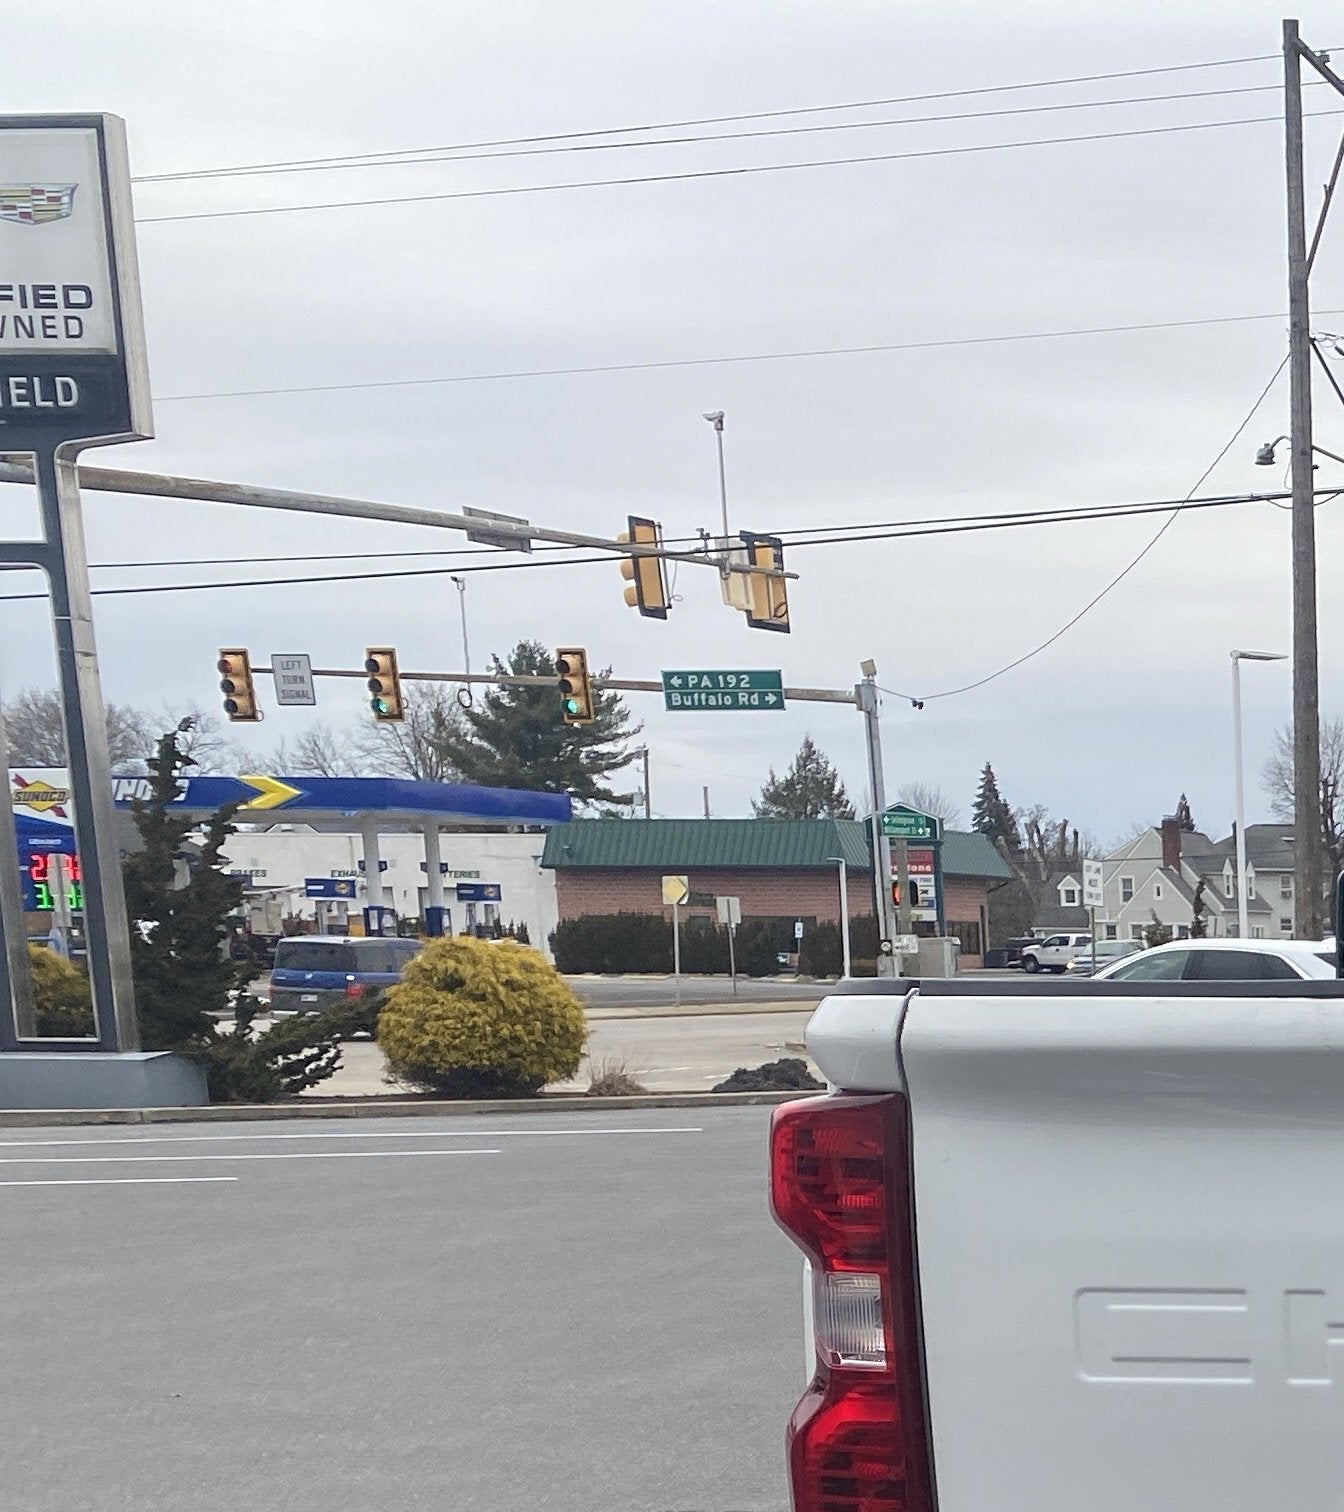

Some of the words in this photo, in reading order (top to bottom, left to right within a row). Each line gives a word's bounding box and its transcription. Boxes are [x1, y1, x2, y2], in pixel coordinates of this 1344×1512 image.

[0, 376, 79, 408] ELD
[281, 660, 301, 670] LEFT
[282, 675, 305, 684] TURN
[688, 675, 712, 688] PA
[718, 674, 751, 688] 192
[281, 689, 312, 699] SIGNAL
[671, 692, 732, 706] Buffalo
[738, 692, 759, 706] Rd
[14, 791, 66, 802] SUNOCO
